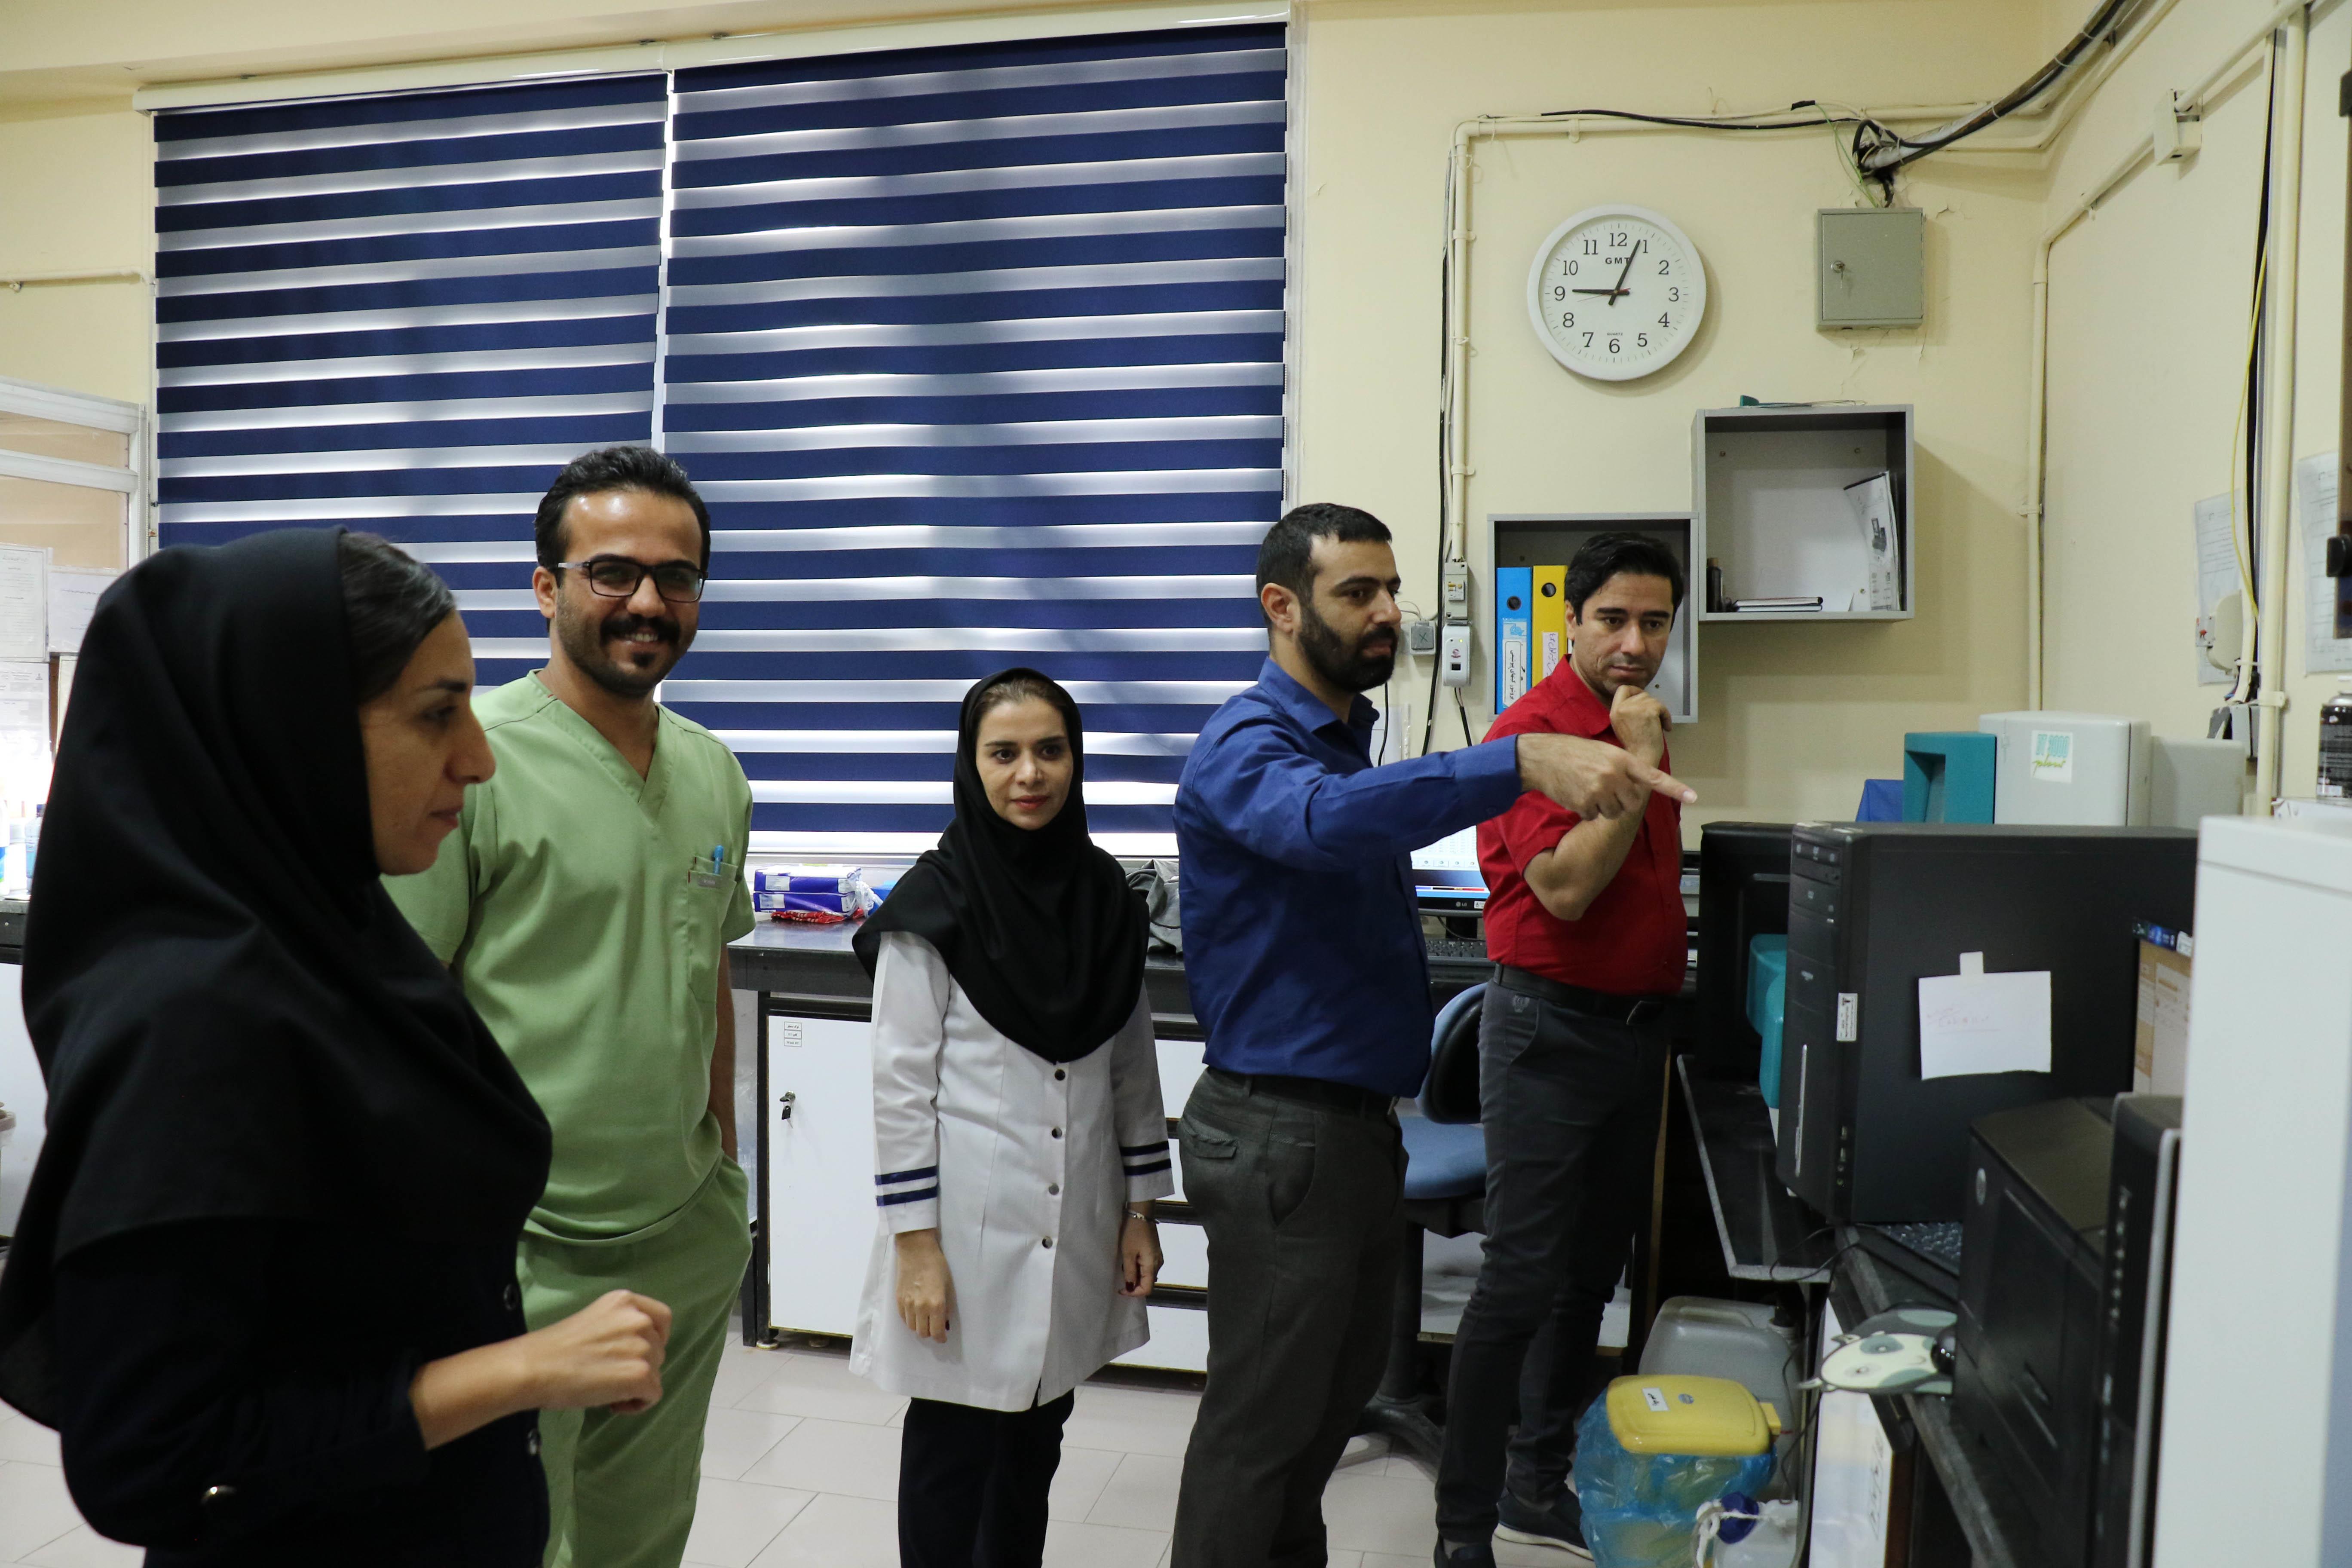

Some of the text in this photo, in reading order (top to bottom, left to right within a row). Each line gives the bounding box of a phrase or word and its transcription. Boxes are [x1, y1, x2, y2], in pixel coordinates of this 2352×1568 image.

[1583, 240, 1599, 255] 11
[1609, 233, 1627, 247] 12
[1642, 240, 1648, 254] 1
[1563, 260, 1578, 276] 10
[1658, 260, 1669, 275] 2
[1554, 286, 1565, 301] 9
[1668, 287, 1679, 302] 3
[1563, 312, 1574, 328] 8
[1658, 312, 1670, 327] 4
[1582, 332, 1594, 347] 7
[1609, 339, 1620, 353] 6
[1637, 333, 1648, 347] 5
